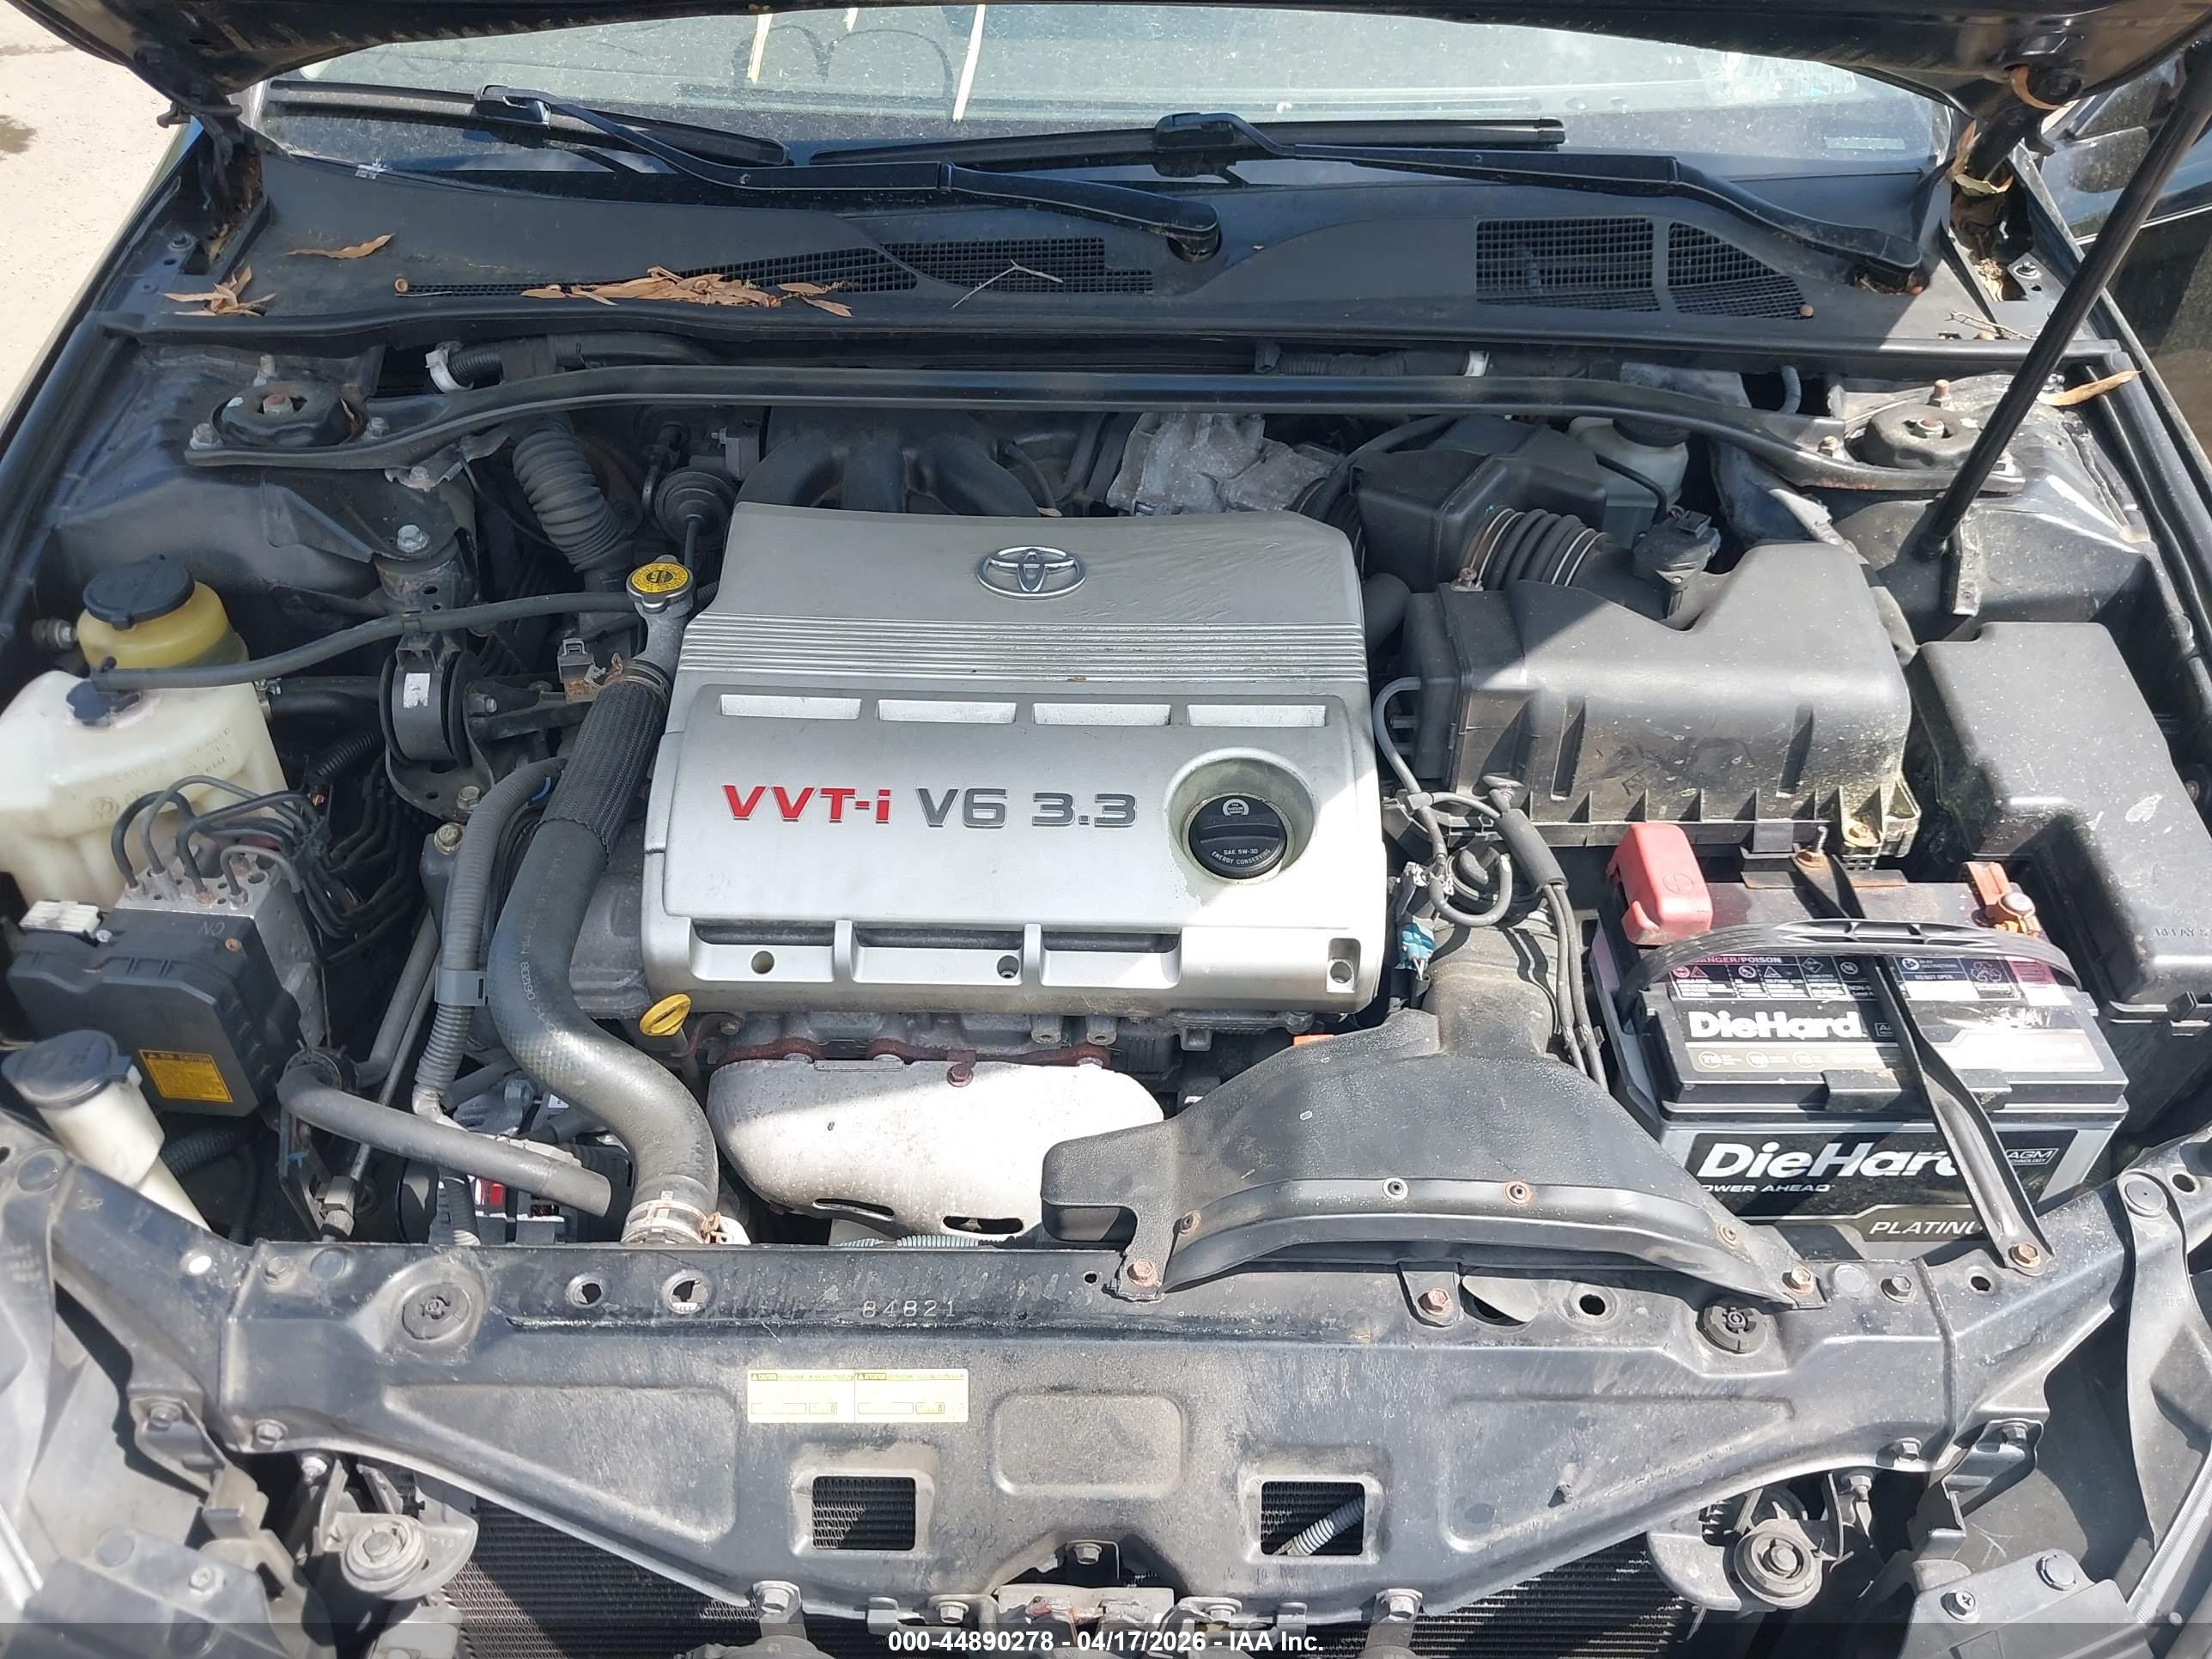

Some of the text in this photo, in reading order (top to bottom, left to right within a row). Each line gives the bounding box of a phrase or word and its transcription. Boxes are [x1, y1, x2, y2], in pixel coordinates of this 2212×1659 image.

[722, 784, 1138, 828] VVT-i V6 3.3
[1211, 848, 1271, 865] ENERGY CONSERVING
[1688, 1010, 1863, 1040] DieHard
[2008, 1151, 2053, 1159] AGM
[1701, 1184, 1831, 1193] OWER AHEAD
[862, 1299, 956, 1318] 84821
